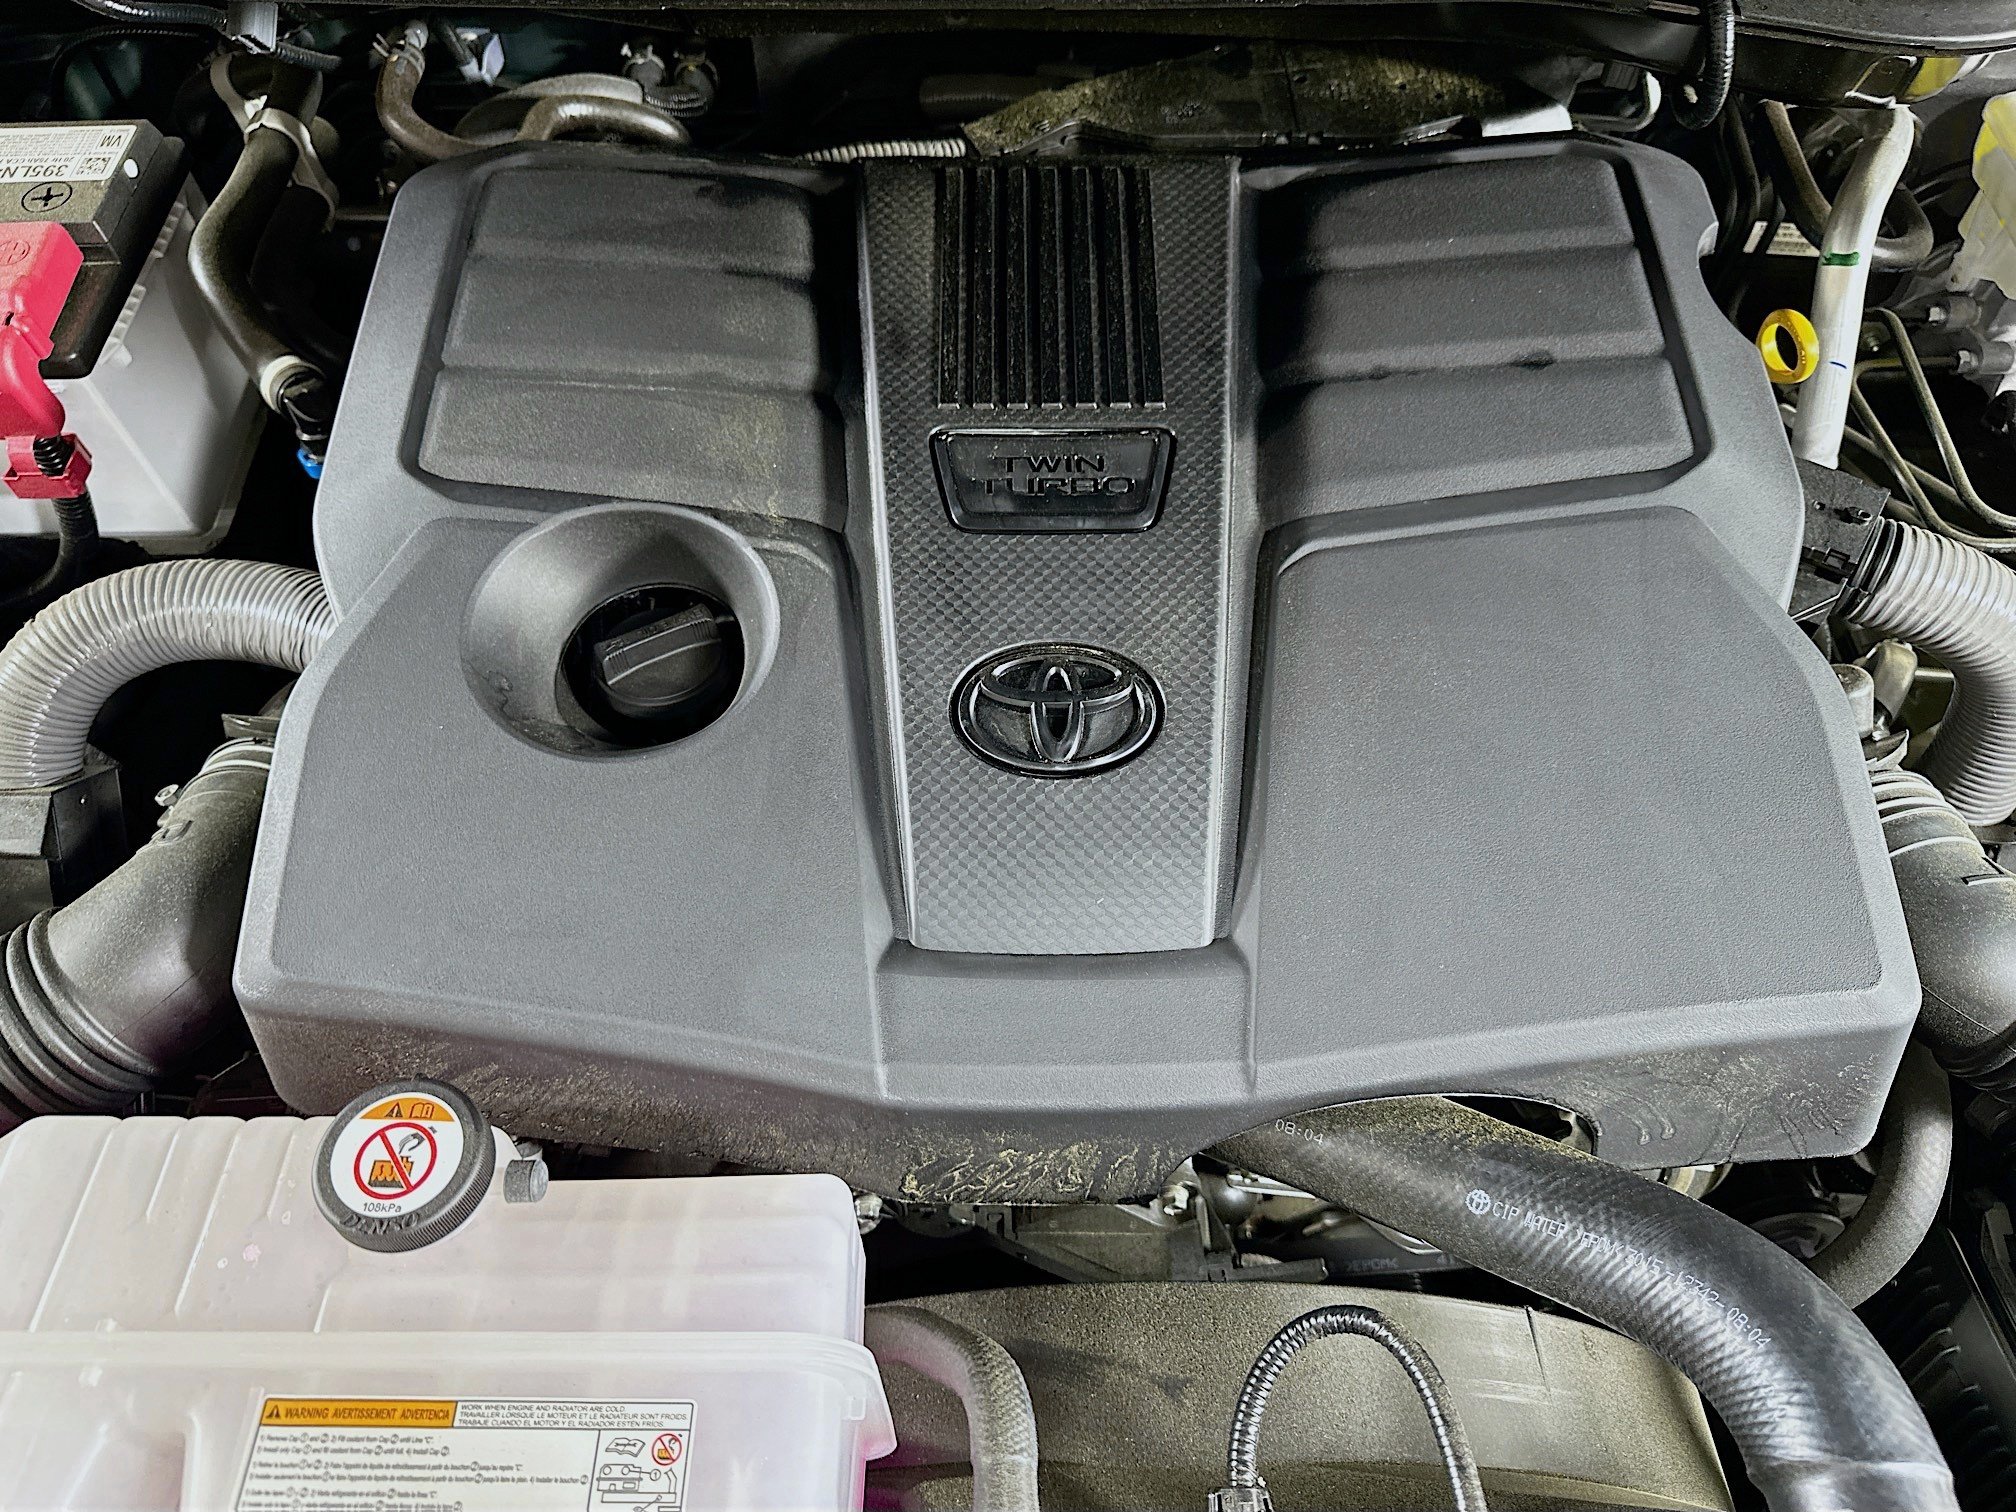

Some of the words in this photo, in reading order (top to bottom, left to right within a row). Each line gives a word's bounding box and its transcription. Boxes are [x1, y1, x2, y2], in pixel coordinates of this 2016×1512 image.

[100, 134, 122, 147] VM
[993, 453, 1106, 474] TWIN
[980, 476, 1137, 497] TURBO
[1276, 1119, 1323, 1144] 08:04
[363, 1202, 401, 1212] 108kPa
[1493, 1202, 1520, 1220] CIP
[1524, 1210, 1568, 1237] WATER
[285, 1408, 330, 1419] WARNING
[332, 1408, 398, 1419] AVERTISSEMENT
[400, 1409, 450, 1420] ADVERTENCIA
